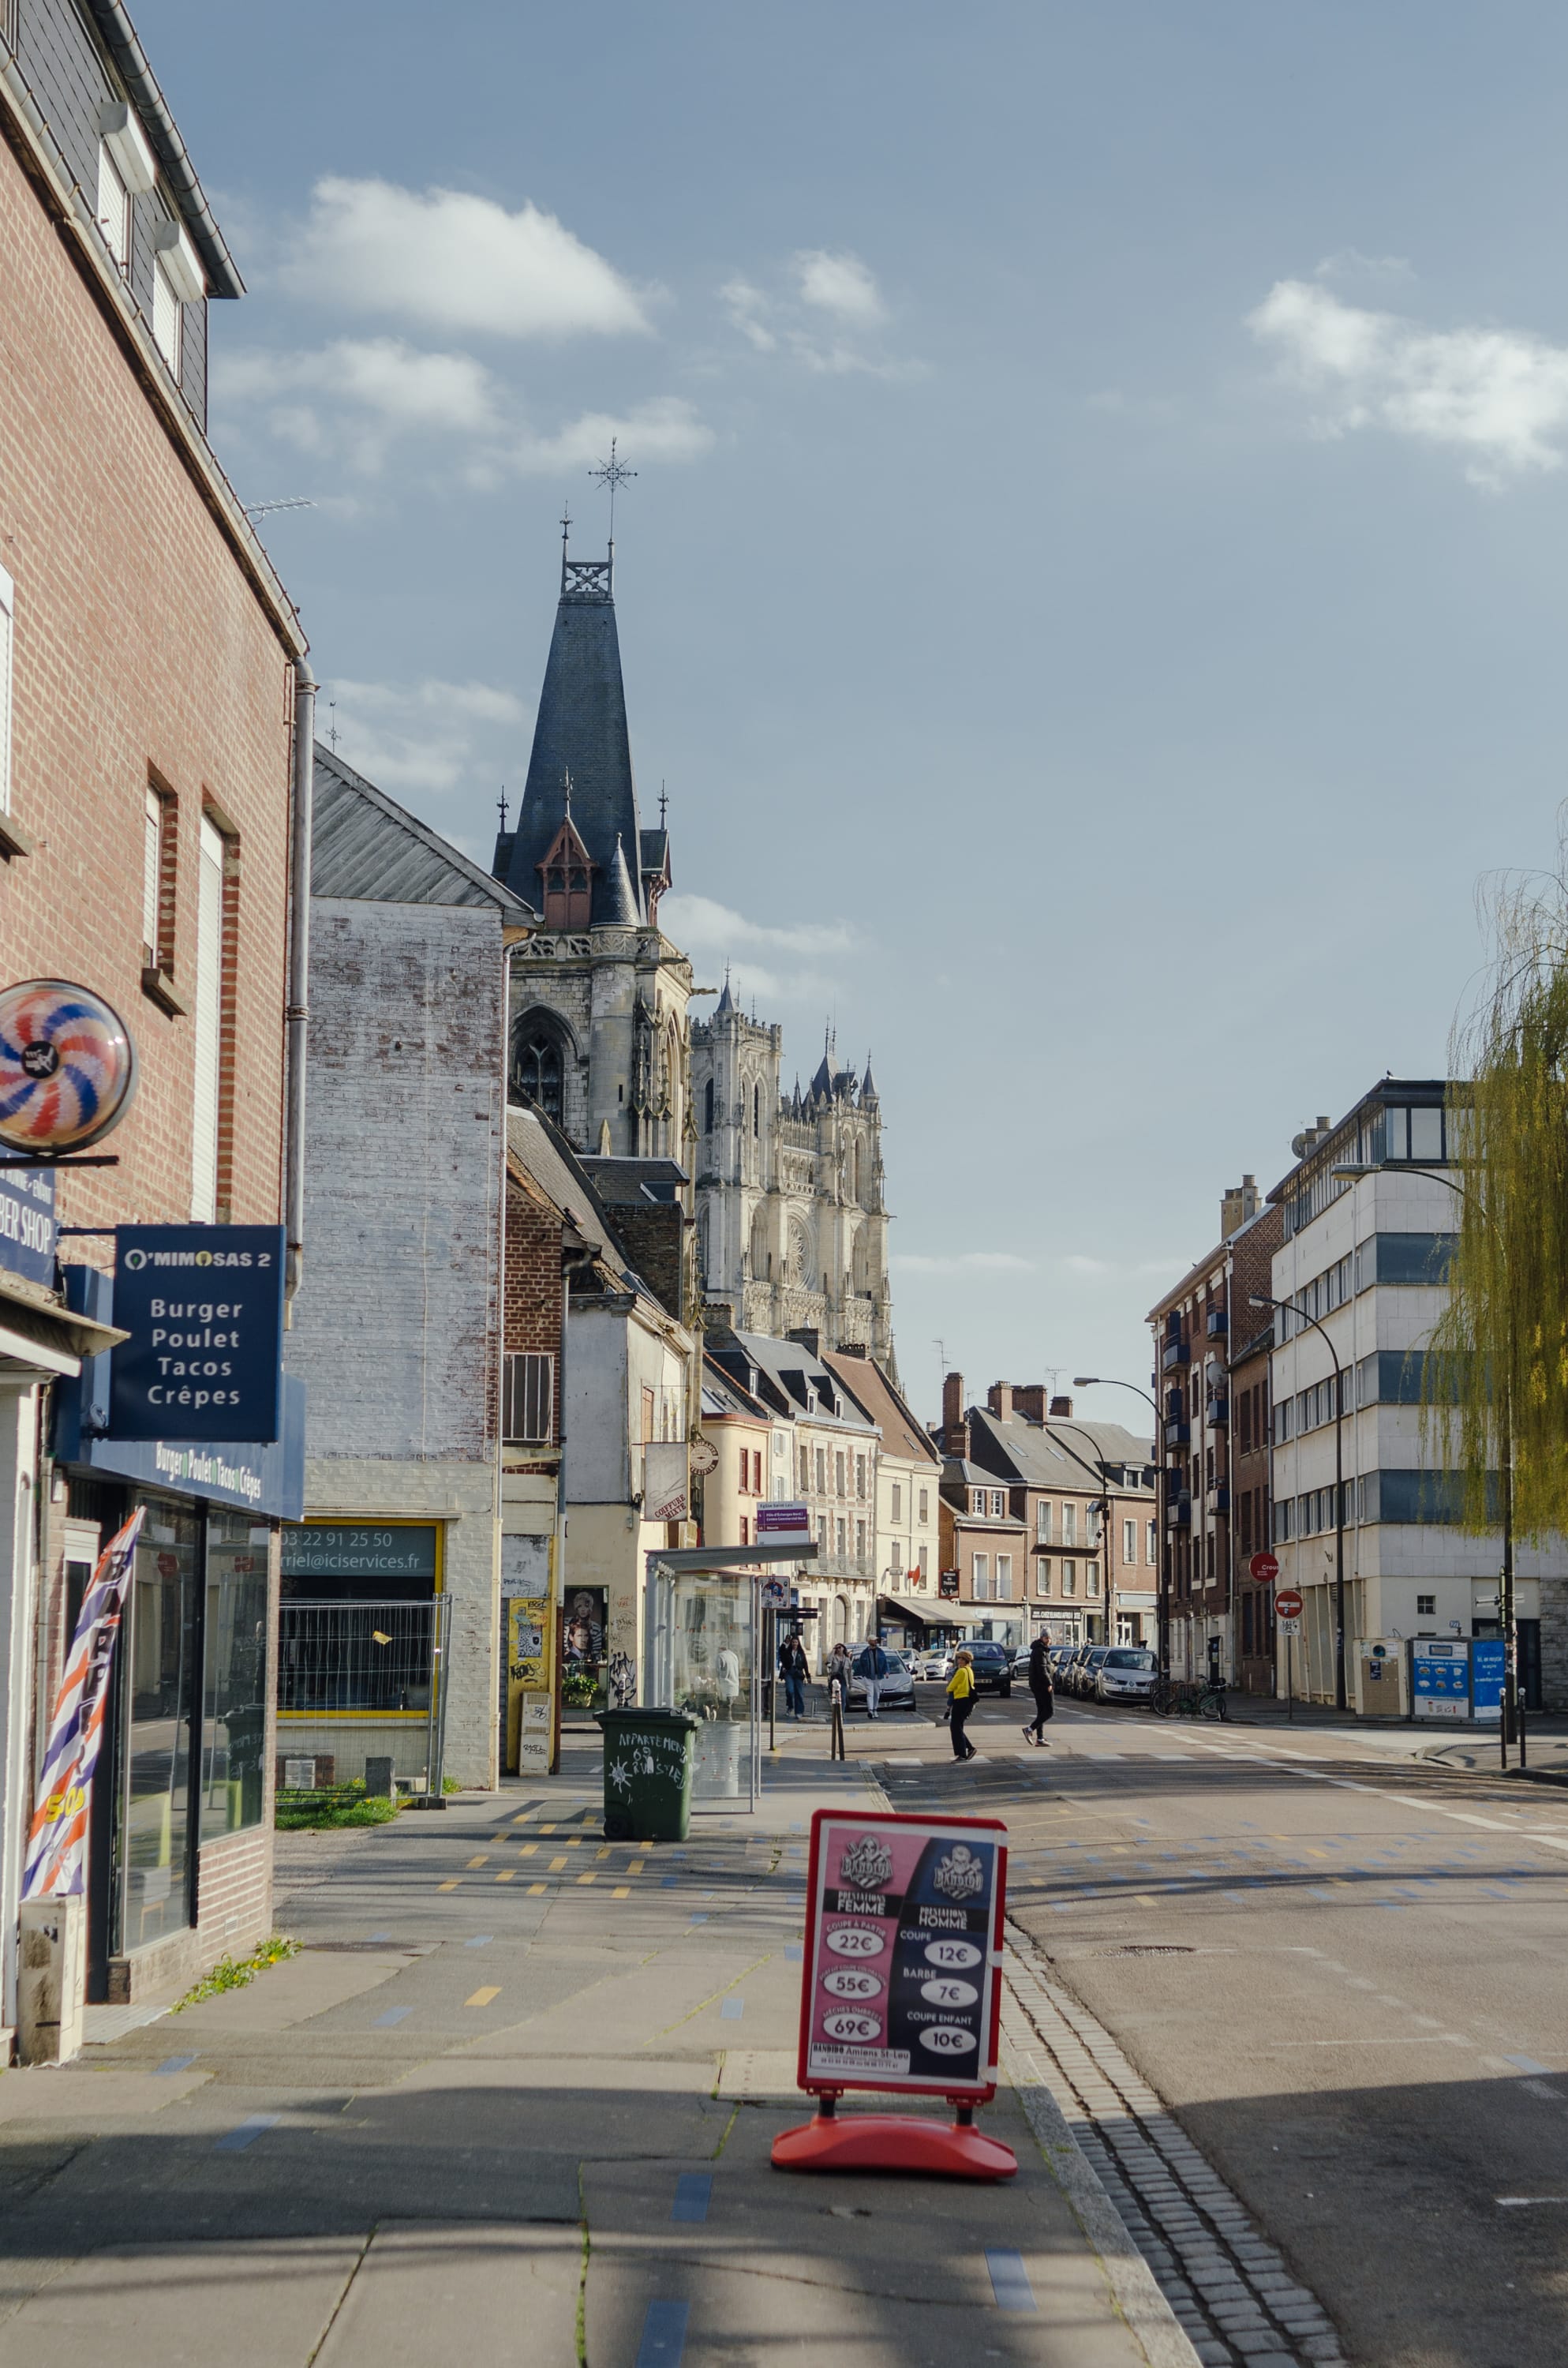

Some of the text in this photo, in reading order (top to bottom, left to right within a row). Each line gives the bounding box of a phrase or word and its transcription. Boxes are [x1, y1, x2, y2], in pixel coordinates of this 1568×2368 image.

[21, 1206, 51, 1254] SHOP
[258, 1253, 271, 1267] 2
[151, 1298, 243, 1323] Burger
[152, 1328, 240, 1347] Poulet
[158, 1357, 232, 1377] Tacos
[148, 1385, 240, 1409] Crêpes
[156, 1441, 182, 1482] Burger
[188, 1449, 213, 1484] Poulet
[217, 1456, 236, 1491] Tacos
[654, 1493, 687, 1519] COIFFURE
[664, 1502, 688, 1520] MIXTE
[281, 1531, 392, 1547] 03 22 91 25 50
[44, 1786, 86, 1825] SOP
[837, 1899, 885, 1916] FEMME
[919, 1913, 967, 1931] HOMME
[839, 1935, 872, 1952] 22€
[900, 1930, 931, 1941] COUPE
[938, 1946, 968, 1963] 12€
[903, 1967, 937, 1980] BARBE
[836, 1976, 870, 1993] 55€
[939, 1985, 960, 2002] 7€
[907, 2011, 973, 2025] COUPE ENFANT
[834, 2019, 870, 2038] 69€
[933, 2032, 964, 2048] 10€
[846, 2045, 878, 2058] Amiens
